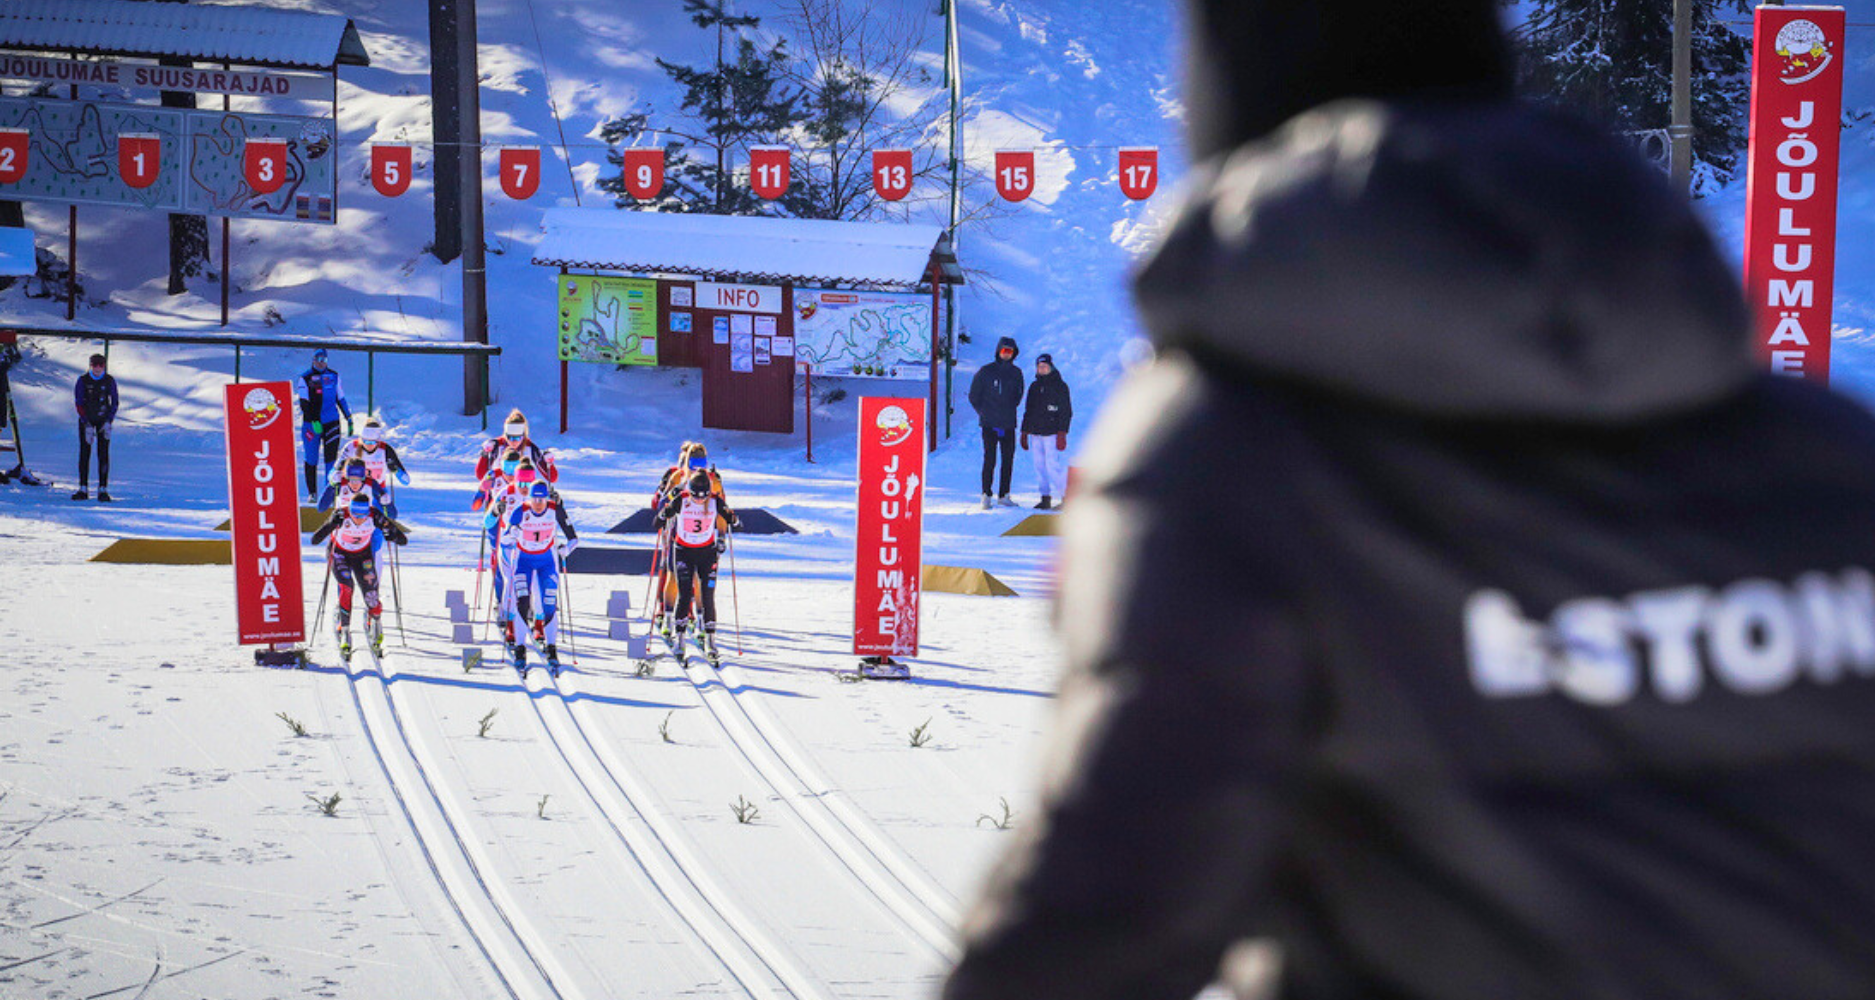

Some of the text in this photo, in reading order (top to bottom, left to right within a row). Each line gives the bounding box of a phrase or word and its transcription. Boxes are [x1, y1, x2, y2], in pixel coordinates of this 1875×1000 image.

[135, 67, 290, 95] SUUSARAJAD
[0, 147, 15, 172] 2
[133, 152, 145, 176] 1
[258, 157, 274, 182] 3
[384, 161, 399, 186] 5
[513, 164, 528, 188] 7
[637, 164, 652, 189] 9
[757, 163, 781, 188] 11
[878, 166, 906, 190] 13
[1000, 166, 1028, 191] 15
[1124, 165, 1151, 189] 17
[1767, 100, 1818, 378] JÕULUMÄE
[717, 288, 760, 308] INFO
[253, 440, 281, 622] JÕULUMÄE
[533, 531, 540, 542] 1
[692, 519, 702, 533] 3
[877, 454, 901, 635] JÕULUMÄE
